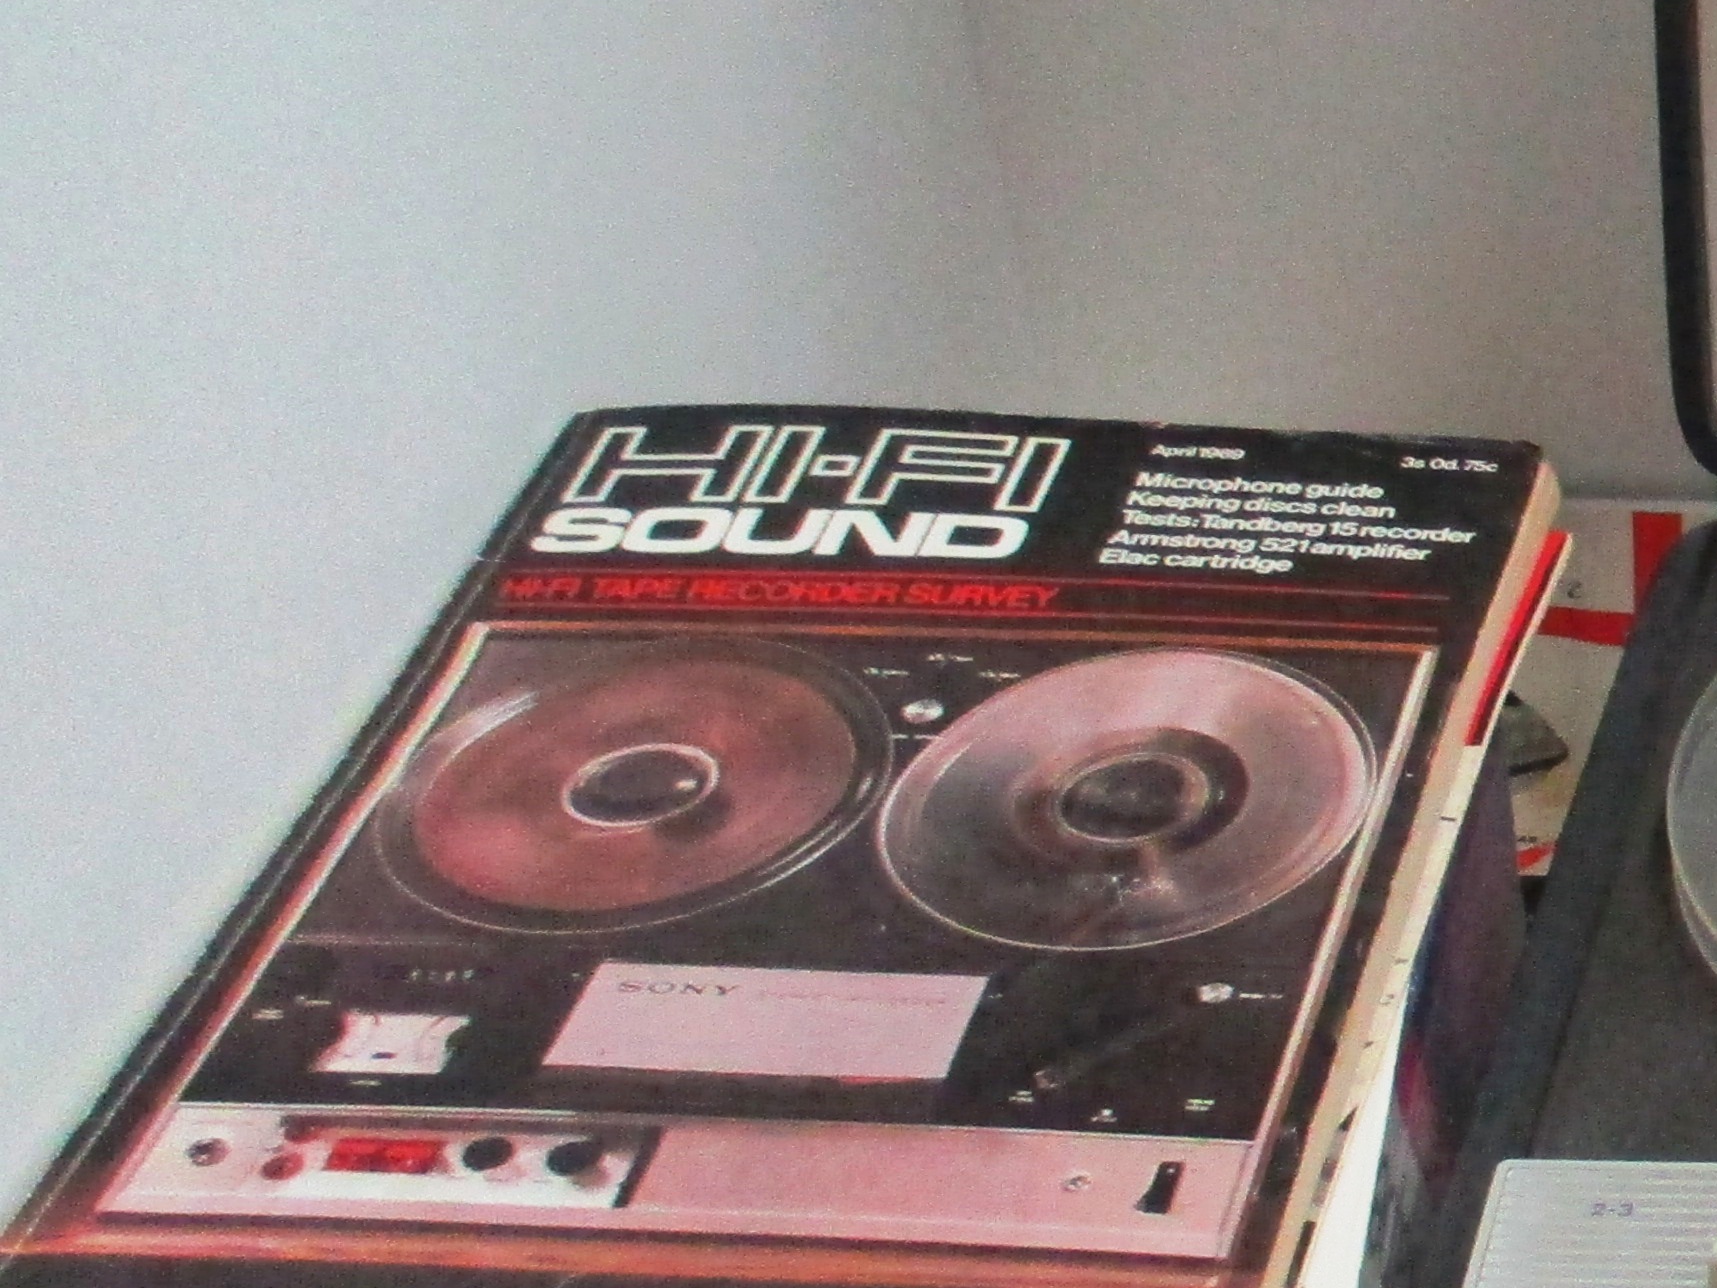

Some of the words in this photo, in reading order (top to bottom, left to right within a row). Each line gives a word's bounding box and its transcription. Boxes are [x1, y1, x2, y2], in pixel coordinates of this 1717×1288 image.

[1149, 444, 1199, 459] April
[1400, 456, 1425, 470] 3s
[1463, 459, 1499, 474] 75c
[1135, 472, 1300, 498] Microphone
[1304, 482, 1385, 500] guide
[1125, 491, 1241, 513] Keeping
[1243, 497, 1318, 514] discs
[1320, 503, 1396, 519] clean
[531, 507, 1030, 559] SOUND
[1122, 509, 1199, 528] Tests:
[1200, 515, 1326, 538] Tandberg
[1329, 521, 1357, 537] 15
[1358, 524, 1477, 543] recorder
[1107, 529, 1256, 553] Armstrong
[1258, 537, 1309, 553] 521
[1310, 540, 1432, 562] amplifier
[1099, 548, 1159, 566] Elac
[1163, 554, 1294, 573] cartridge
[593, 578, 680, 601] TAPE
[688, 579, 898, 605] RECORDER
[902, 582, 1061, 609] SURVEY
[617, 979, 740, 997] SONY
